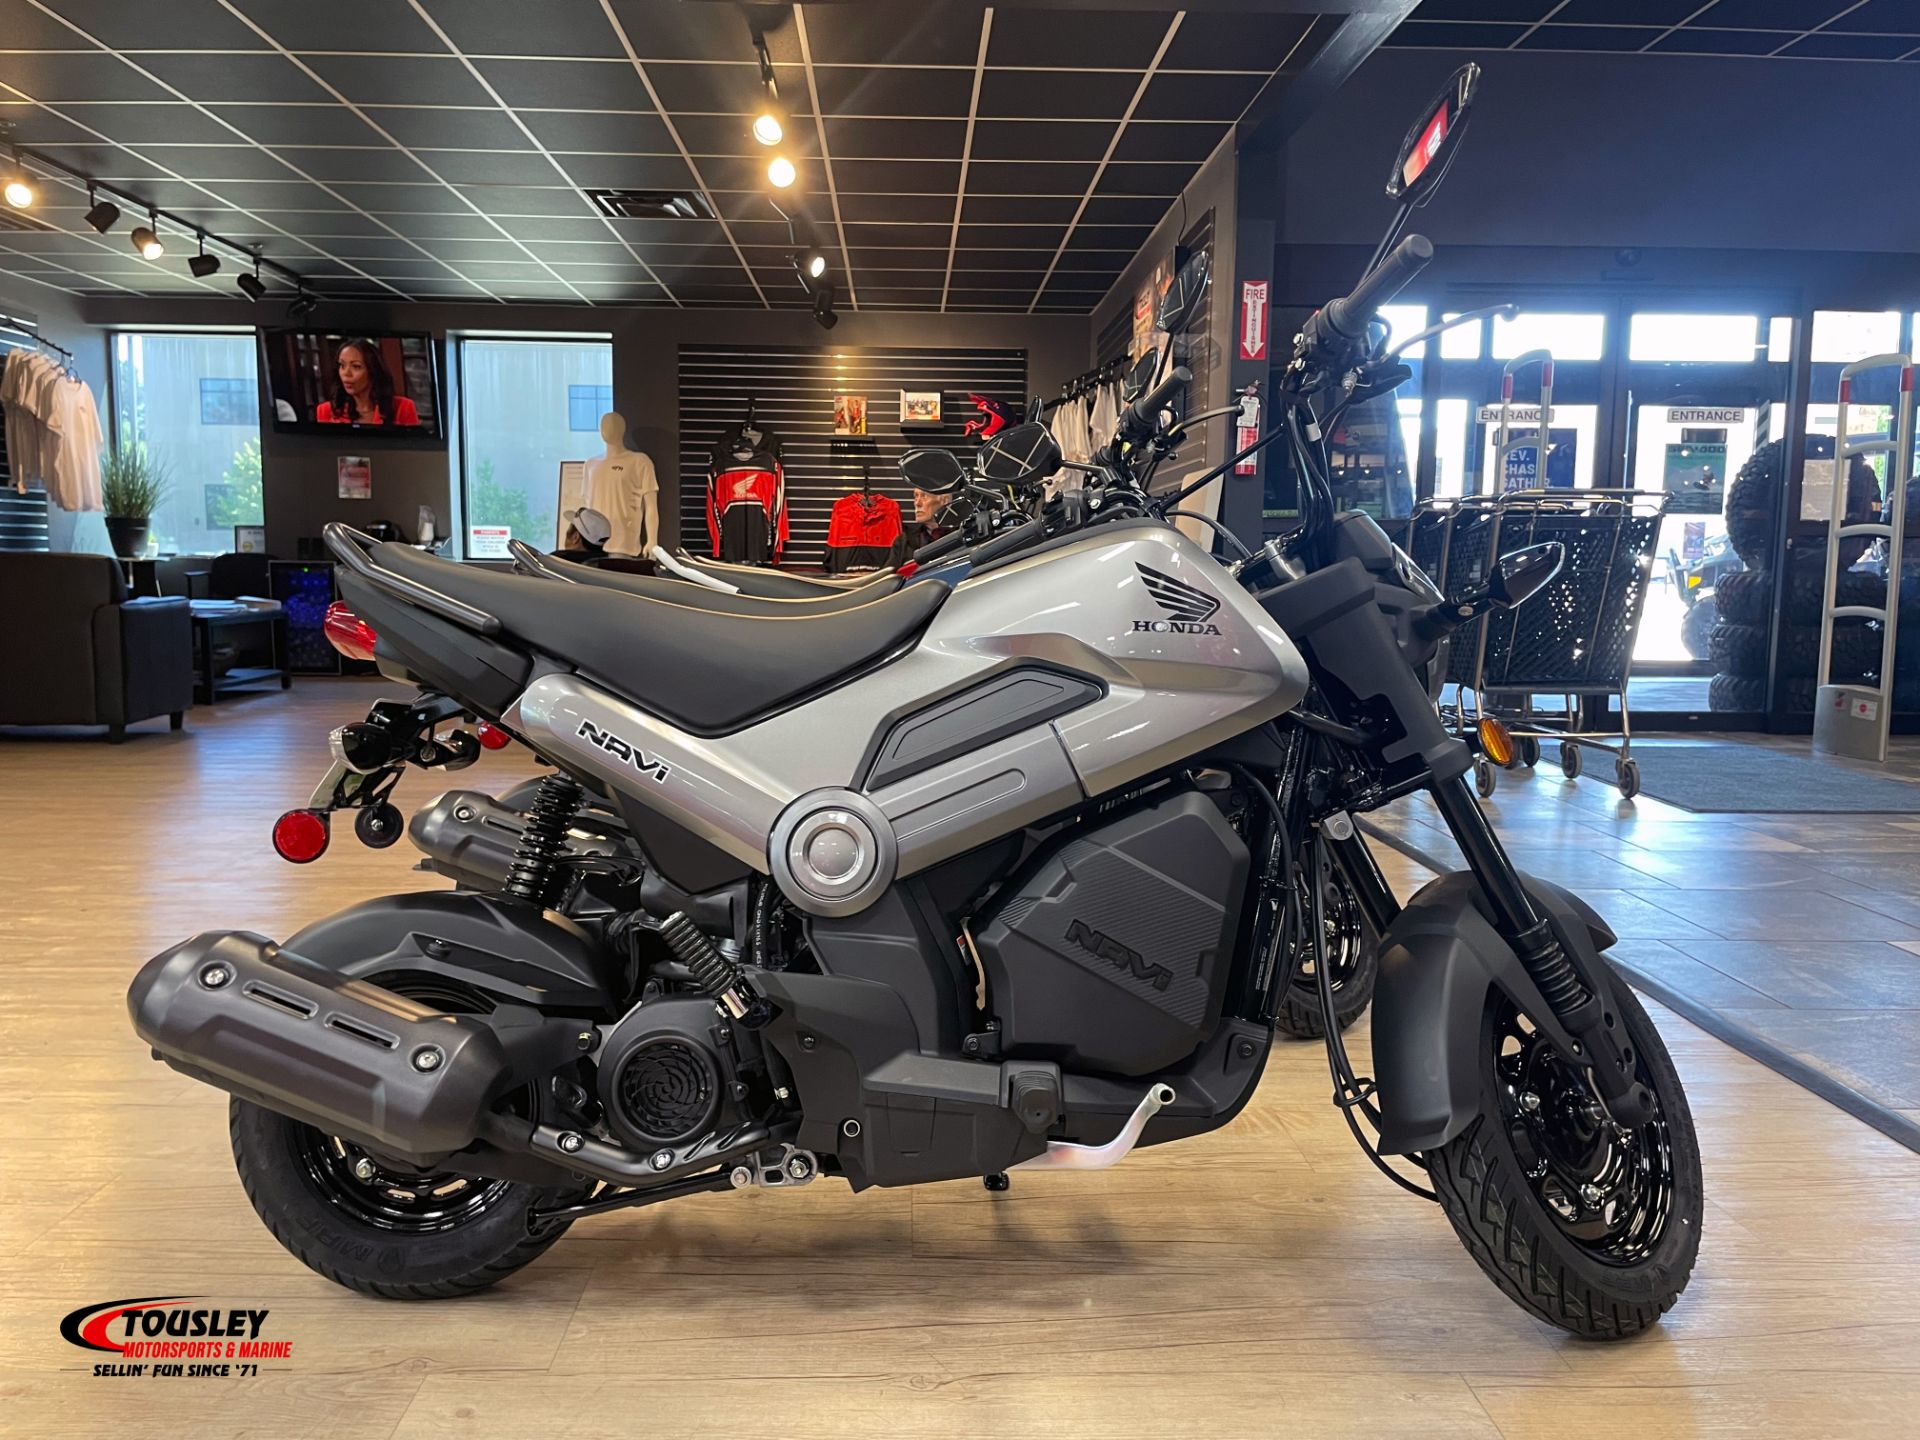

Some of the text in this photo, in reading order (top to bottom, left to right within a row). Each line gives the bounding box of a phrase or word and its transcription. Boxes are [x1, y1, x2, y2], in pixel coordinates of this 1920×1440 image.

[1245, 288, 1265, 300] FIRE
[1481, 410, 1543, 420] ENRANC
[1671, 410, 1741, 421] ENTRANCE
[1506, 449, 1530, 461] EV.
[1132, 620, 1223, 636] HONDA
